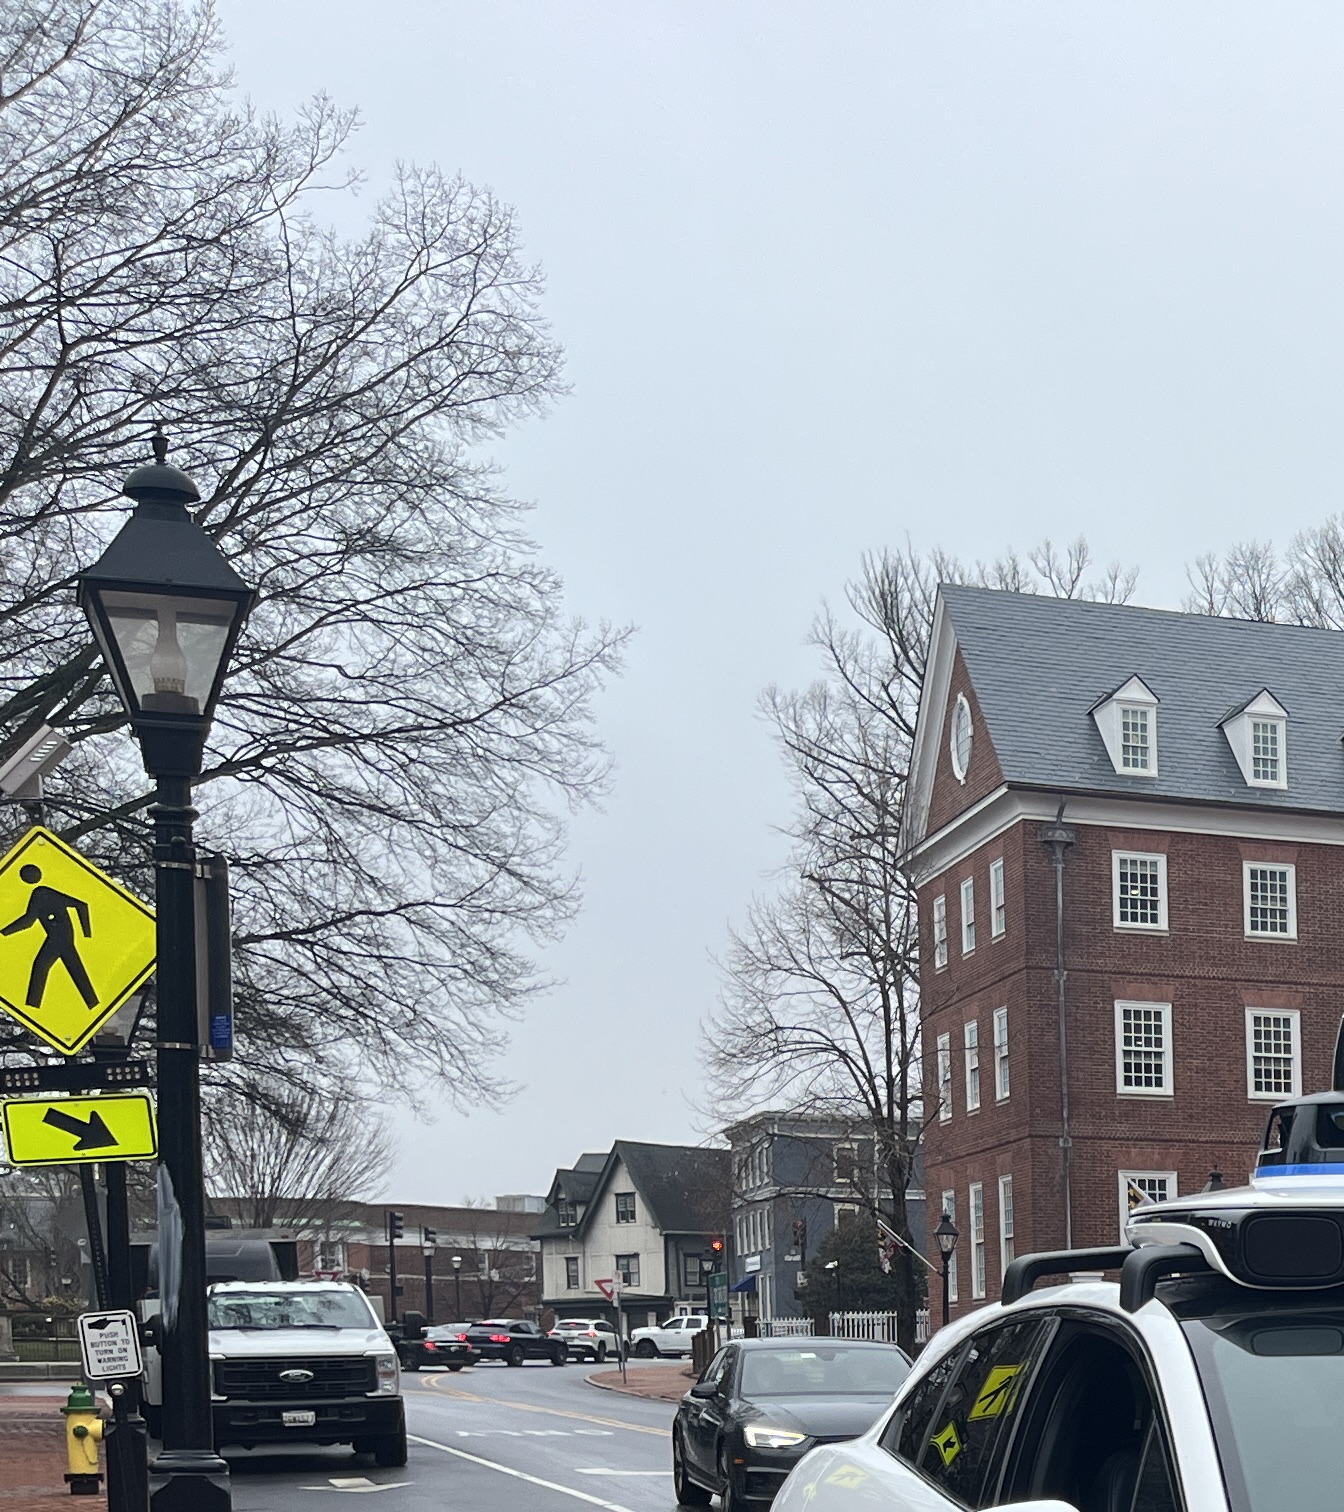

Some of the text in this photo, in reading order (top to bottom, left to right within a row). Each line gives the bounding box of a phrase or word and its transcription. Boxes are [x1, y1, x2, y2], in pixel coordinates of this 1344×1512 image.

[99, 1331, 119, 1339] PUSH
[90, 1338, 130, 1348] BUTTON TO
[97, 1356, 129, 1364] WARNING
[102, 1364, 127, 1372] LIGHTS
